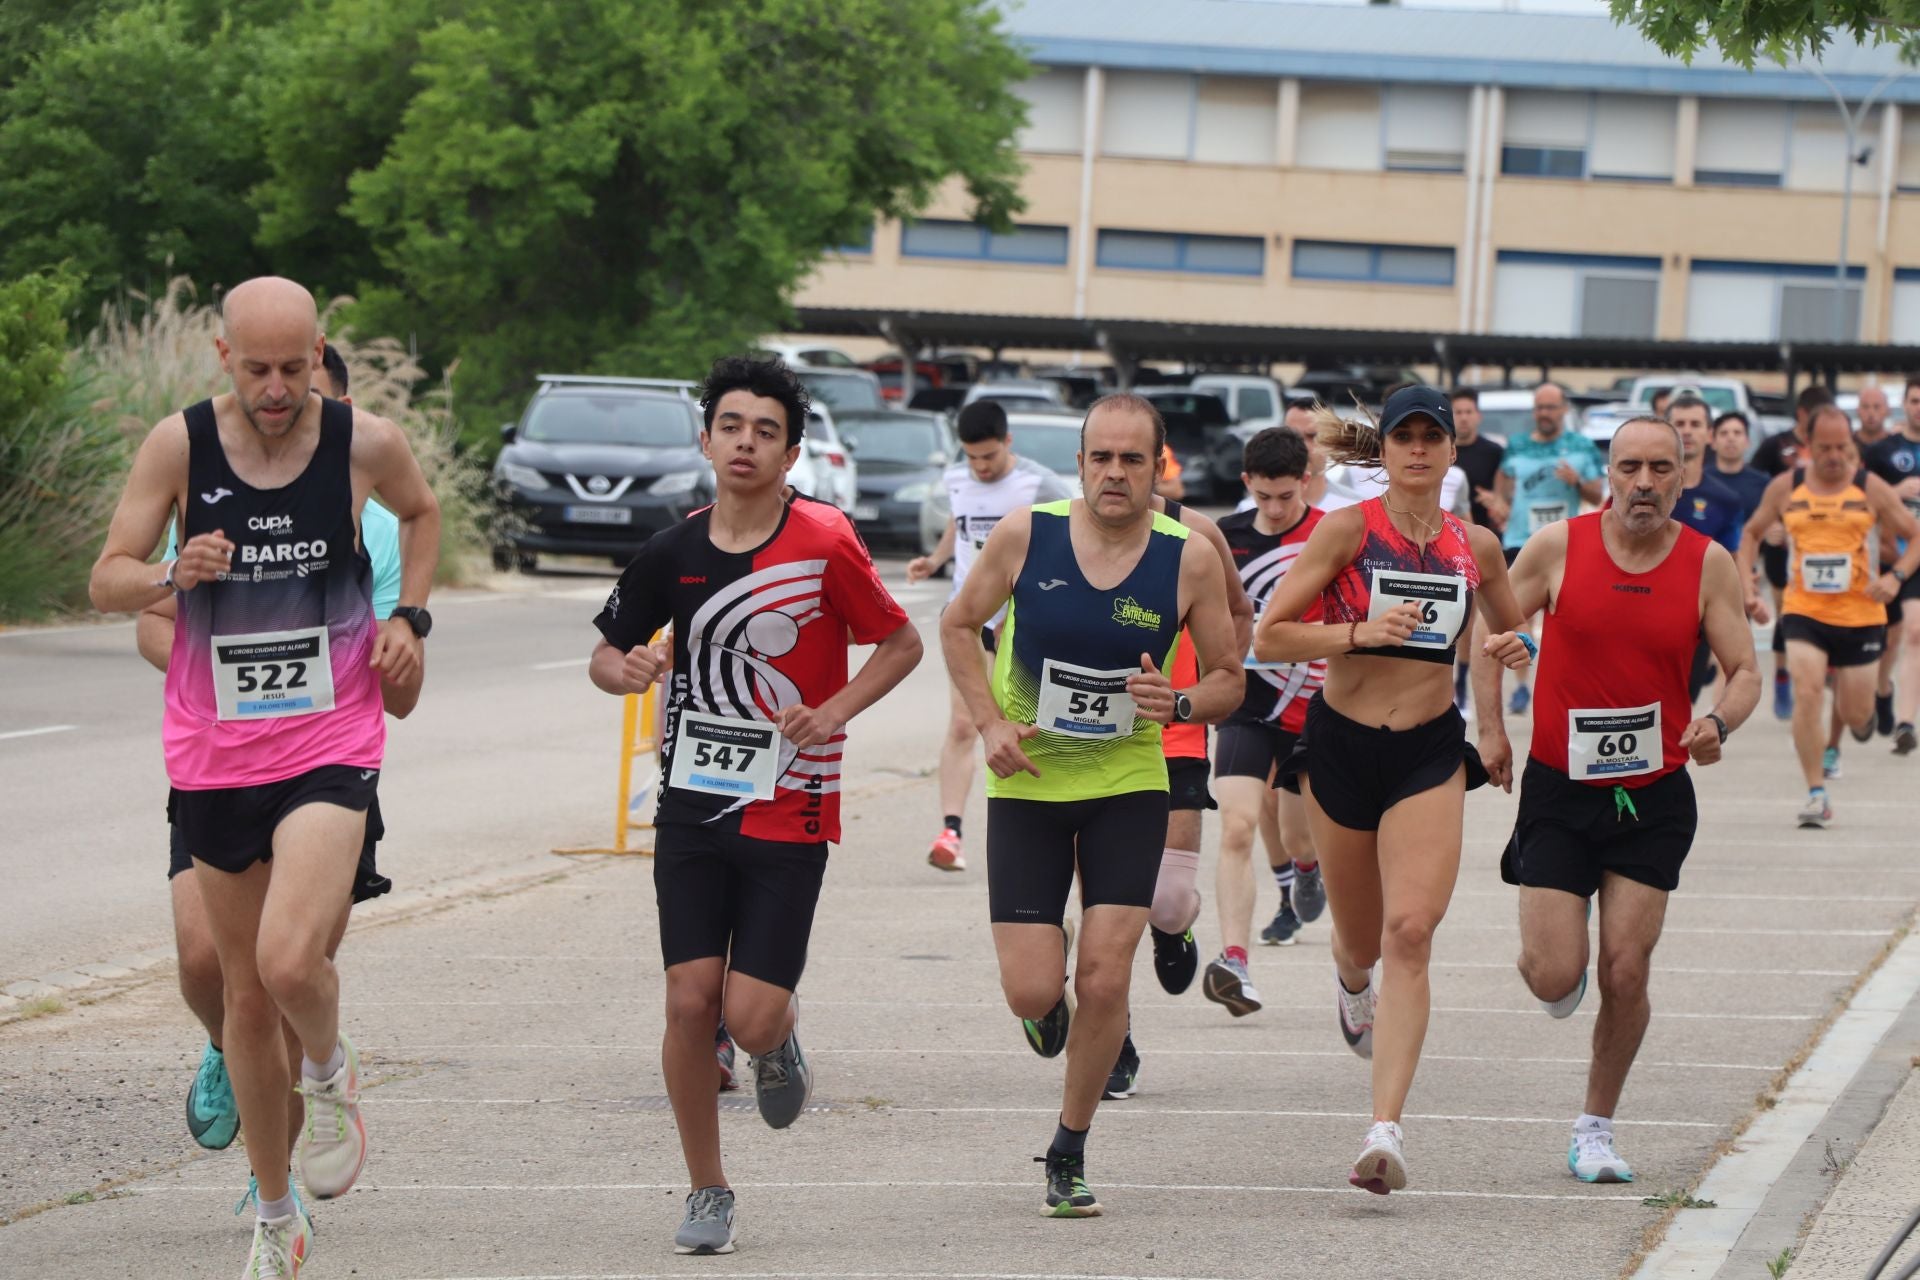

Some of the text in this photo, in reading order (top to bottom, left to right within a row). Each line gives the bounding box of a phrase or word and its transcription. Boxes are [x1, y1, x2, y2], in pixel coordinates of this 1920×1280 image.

[248, 515, 293, 530] CUPA
[242, 540, 328, 563] BARCO
[254, 646, 277, 654] CIUDAD
[287, 642, 310, 651] ALFARO
[237, 661, 307, 692] 522
[1080, 678, 1100, 686] CIUDAD
[262, 692, 286, 700] JESUS
[1068, 692, 1109, 717] 54
[1074, 716, 1101, 724] MIGUEL
[699, 725, 713, 733] CROSS
[714, 728, 733, 736] CIUDAD
[1597, 733, 1638, 756] 60
[694, 742, 756, 772] 547
[801, 773, 823, 835] club
